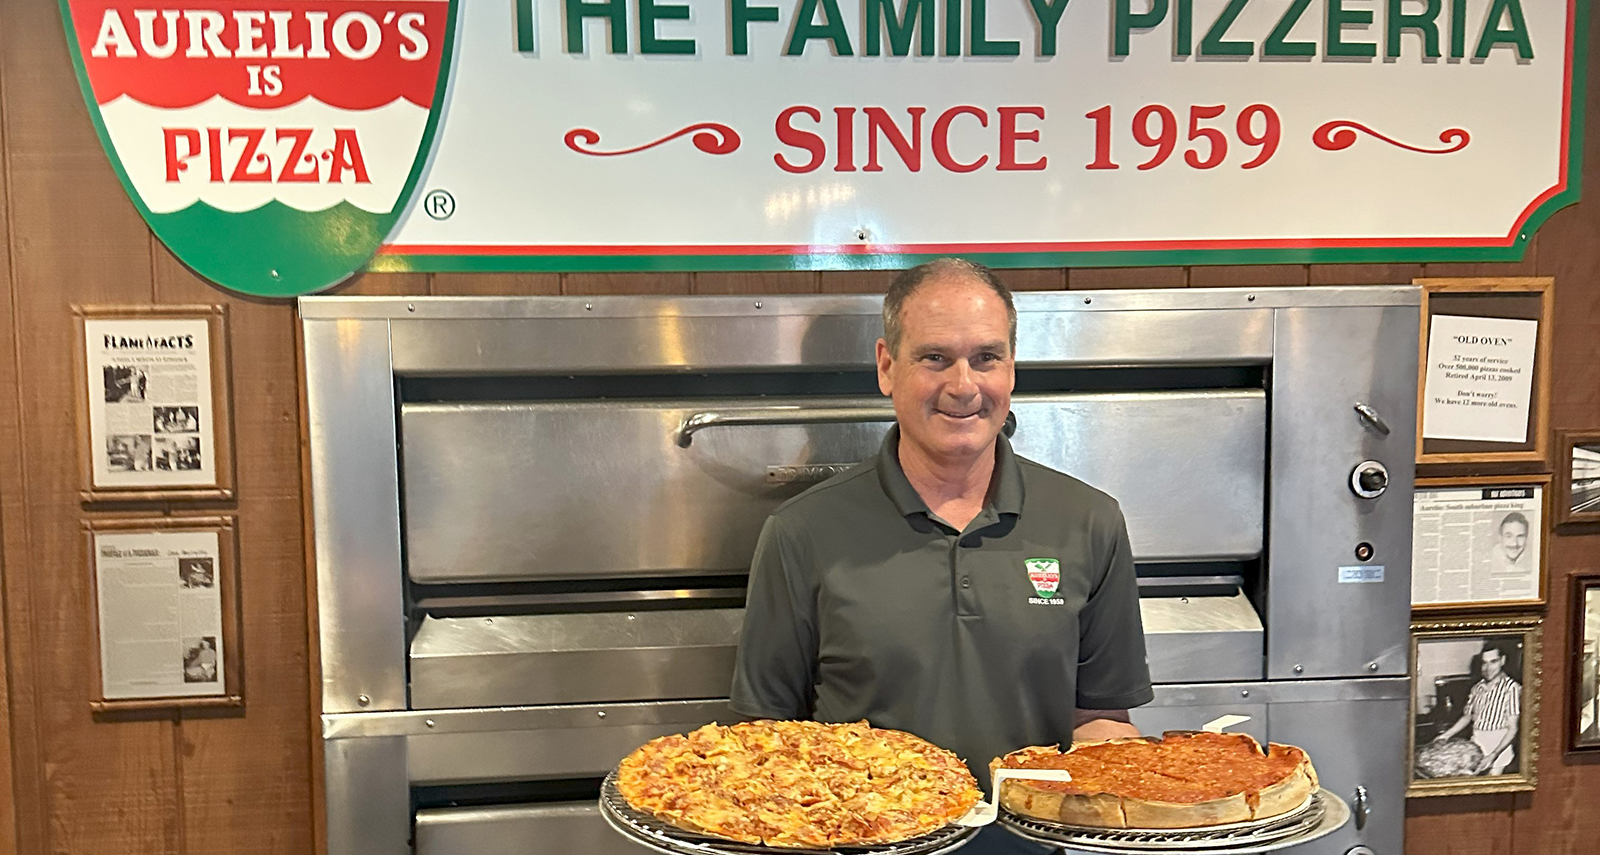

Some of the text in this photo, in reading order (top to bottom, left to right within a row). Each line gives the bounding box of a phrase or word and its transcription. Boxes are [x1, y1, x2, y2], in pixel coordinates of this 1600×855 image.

[91, 10, 429, 60] AURELIO'S
[726, 0, 1066, 58] FAMILY
[1108, 0, 1534, 62] PIZZERIA
[246, 65, 283, 97] IS
[773, 104, 1281, 174] SINCE 1959
[162, 127, 372, 184] PIZZA
[1462, 356, 1478, 364] years
[1487, 357, 1509, 365] service
[1438, 362, 1454, 370] Over
[1480, 365, 1499, 373] pizzas
[1445, 372, 1469, 380] Retired
[1470, 373, 1487, 381] April
[1434, 397, 1445, 405] We
[1494, 502, 1509, 510] pizza
[1028, 597, 1049, 605] SINCE
